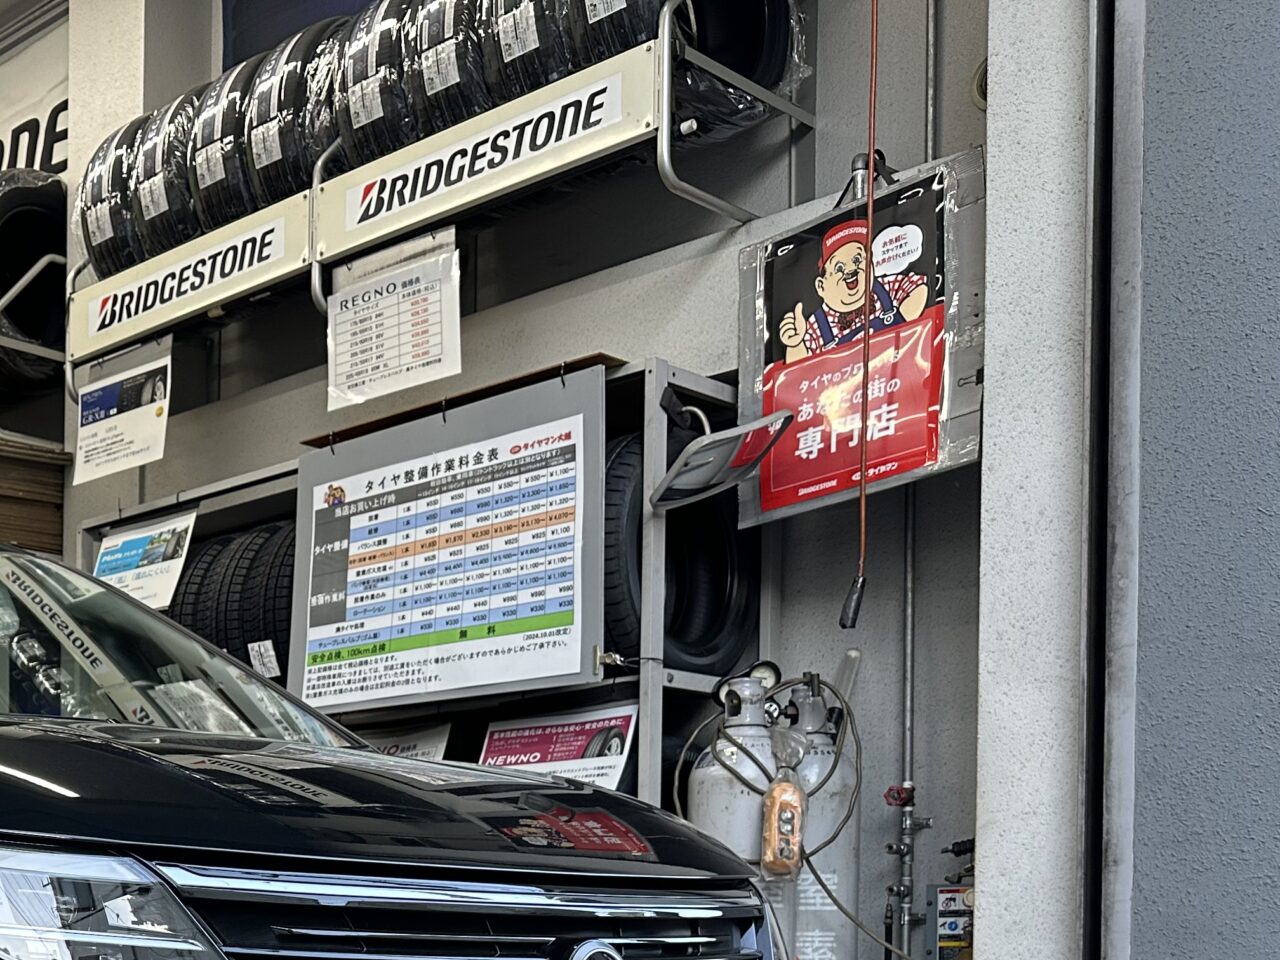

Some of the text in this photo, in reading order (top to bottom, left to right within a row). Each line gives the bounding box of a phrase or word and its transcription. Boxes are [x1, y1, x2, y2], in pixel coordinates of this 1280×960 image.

[357, 87, 608, 224] BRIDGESTONE
[97, 227, 276, 332] BRIDGESTONE
[339, 281, 396, 311] REGNO
[795, 402, 899, 460] 専門店
[364, 446, 498, 494] タイヤ整備作業料金表
[334, 492, 395, 518] 当店お買い上げ時
[313, 538, 348, 556] タイヤ整備
[504, 536, 518, 545] ¥825
[532, 531, 545, 540] ¥825
[551, 525, 570, 536] ¥1,100
[445, 618, 458, 627] ¥330
[473, 613, 486, 622] ¥330
[502, 608, 516, 617] ¥330
[530, 603, 544, 612] ¥330
[558, 598, 572, 608] ¥330
[311, 642, 385, 664] 安全点検、100km点検
[484, 751, 541, 766] NEWNO
